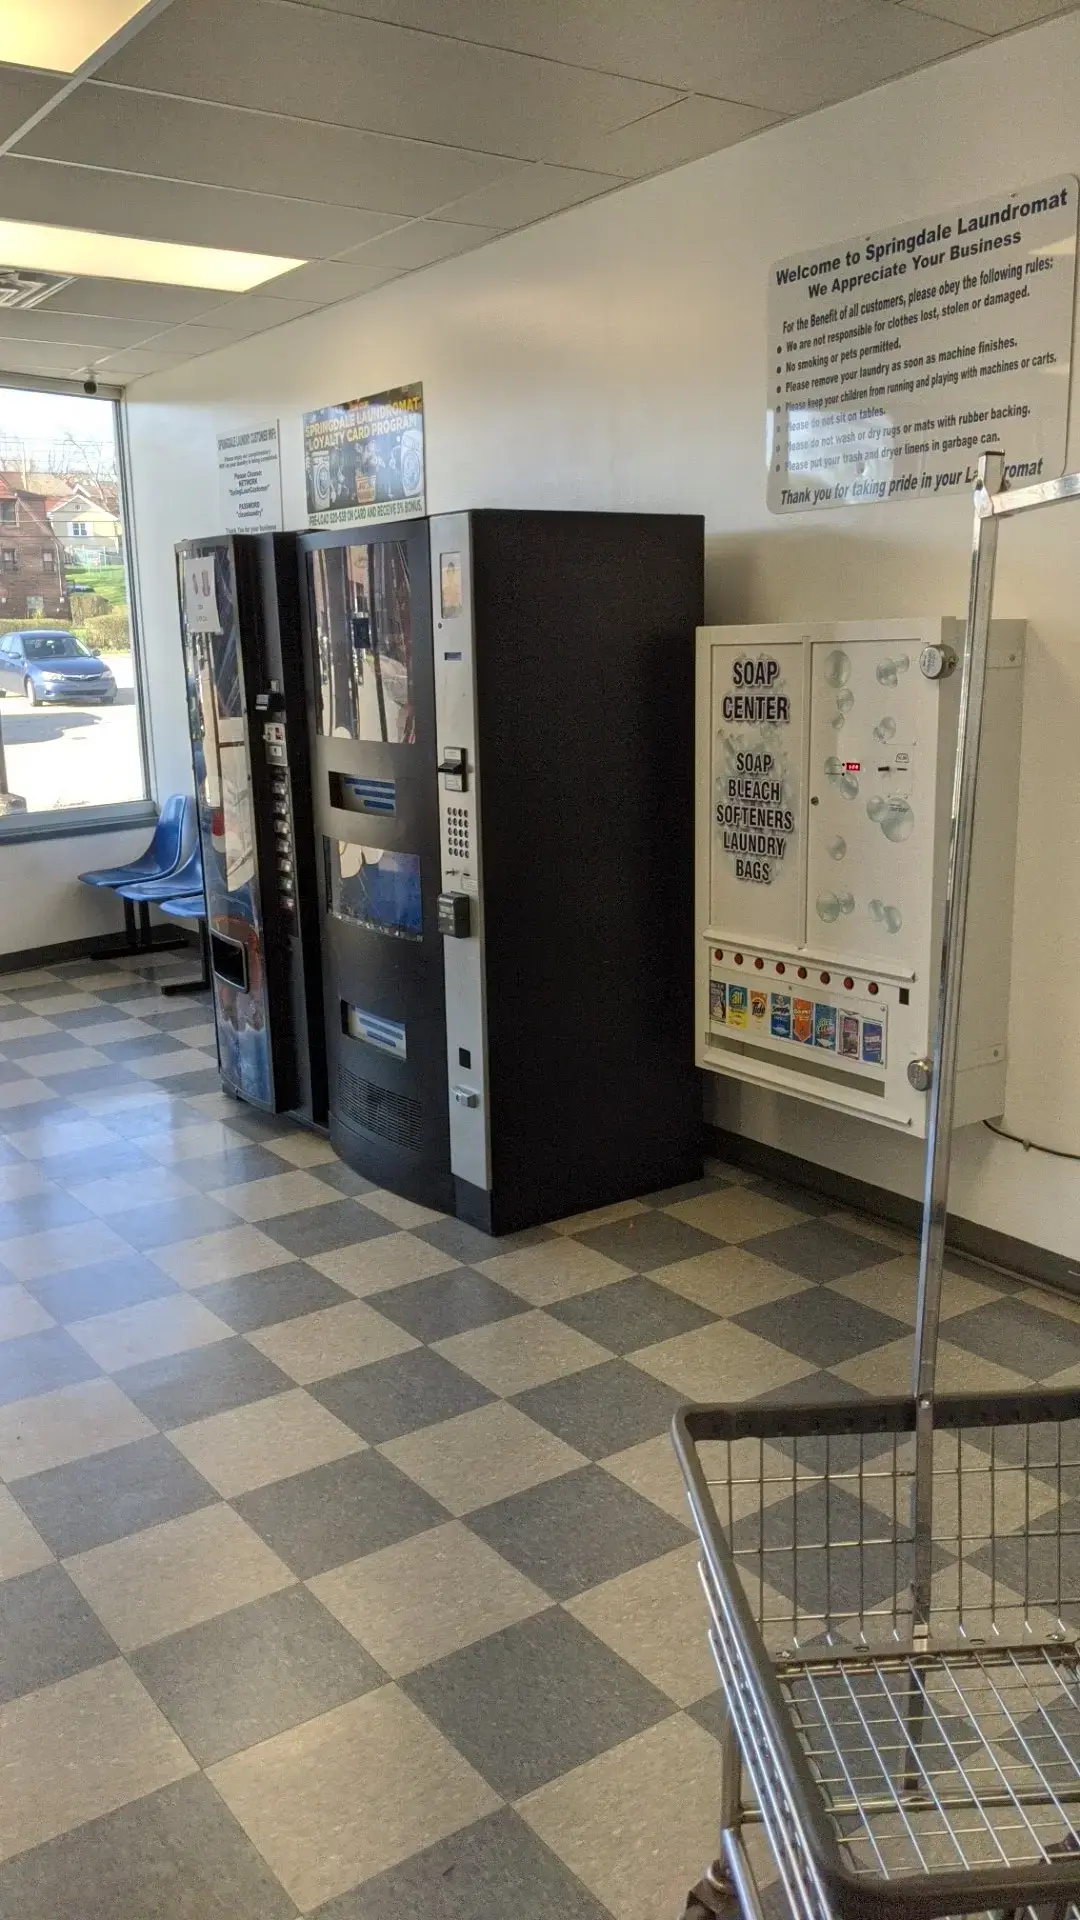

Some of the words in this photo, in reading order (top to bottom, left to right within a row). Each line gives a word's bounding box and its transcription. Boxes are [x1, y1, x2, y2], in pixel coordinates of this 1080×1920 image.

[776, 257, 840, 286] Welcome
[846, 251, 860, 267] to
[866, 224, 951, 261] Springdale
[958, 188, 1068, 234] Laundromat
[808, 279, 828, 298] We
[832, 262, 906, 293] Appreciate
[912, 251, 945, 270] Your
[950, 230, 1021, 260] Business
[783, 321, 794, 334] For
[797, 312, 808, 331] the
[811, 309, 838, 328] Benefit
[840, 308, 848, 321] of
[849, 303, 858, 318] all
[860, 294, 906, 315] customers,
[909, 287, 936, 304] please
[939, 281, 960, 298] obey
[963, 275, 976, 290] the
[980, 264, 1022, 287] following
[1026, 257, 1052, 275] rules:
[786, 341, 797, 352] We
[799, 338, 811, 349] are
[813, 335, 826, 346] not
[828, 324, 872, 344] responsible
[874, 320, 884, 332] for
[888, 313, 918, 329] clothes
[920, 309, 940, 321] lost,
[942, 302, 969, 317] stolen
[972, 299, 981, 309] or
[984, 286, 1030, 306] damaged.
[786, 362, 796, 372] No
[798, 356, 828, 371] smoking
[831, 354, 838, 363] or
[840, 348, 857, 363] pets
[860, 338, 901, 358] permitted.
[786, 379, 809, 392] Please
[811, 374, 838, 386] remove
[840, 370, 857, 383] your
[860, 361, 889, 379] laundry
[892, 360, 900, 371] as
[904, 356, 923, 369] soon
[926, 354, 936, 365] as
[938, 344, 976, 361] machine
[978, 336, 1018, 353] finishes.
[808, 396, 823, 409] keep
[825, 394, 839, 407] your
[840, 387, 868, 402] children
[869, 384, 885, 397] from
[887, 378, 914, 394] running
[916, 375, 929, 388] and
[931, 368, 958, 388] playing
[961, 365, 977, 380] with
[980, 360, 1018, 376] machines
[1021, 357, 1030, 368] or
[1032, 350, 1056, 367] carts.
[305, 413, 355, 438] SPRINGDALE
[357, 396, 420, 424] LAUNDROMAT
[308, 430, 345, 451] LOYALTY
[347, 426, 369, 442] CARD
[372, 415, 416, 434] PROGRAM
[811, 417, 819, 428] do
[822, 414, 834, 428] not
[836, 411, 846, 424] sit
[848, 410, 857, 421] on
[860, 406, 886, 420] tables.
[811, 438, 819, 449] do
[822, 435, 834, 447] not
[836, 430, 856, 444] wash
[858, 430, 866, 440] or
[868, 426, 880, 441] dry
[883, 423, 900, 438] rugs
[903, 422, 912, 432] or
[914, 419, 934, 432] mats
[937, 412, 956, 428] with
[959, 408, 988, 424] rubber
[990, 405, 1030, 420] backing.
[810, 457, 822, 472] put
[824, 455, 840, 468] your
[842, 450, 862, 464] trash
[864, 446, 878, 460] and
[881, 446, 902, 460] dryer
[904, 441, 930, 455] linens
[932, 438, 940, 450] in
[942, 435, 978, 452] garbage
[980, 432, 1000, 444] can.
[781, 487, 811, 505] Thank
[813, 488, 831, 505] you
[834, 484, 849, 498] for
[852, 479, 886, 498] taking
[889, 473, 918, 496] pride
[921, 472, 932, 489] in
[934, 470, 962, 492] your
[964, 458, 1043, 484] Laromat
[355, 507, 366, 520] CARD
[367, 506, 376, 518] AND
[733, 660, 779, 686] SOAP
[723, 696, 789, 720] CENTER
[737, 753, 772, 773] SOAP
[728, 780, 779, 801] BLEACH
[717, 805, 793, 830] SOFTENERS
[724, 831, 785, 856] LAUNDRY
[736, 859, 770, 881] BAGS
[731, 990, 742, 1005] all
[752, 1001, 765, 1016] Tide
